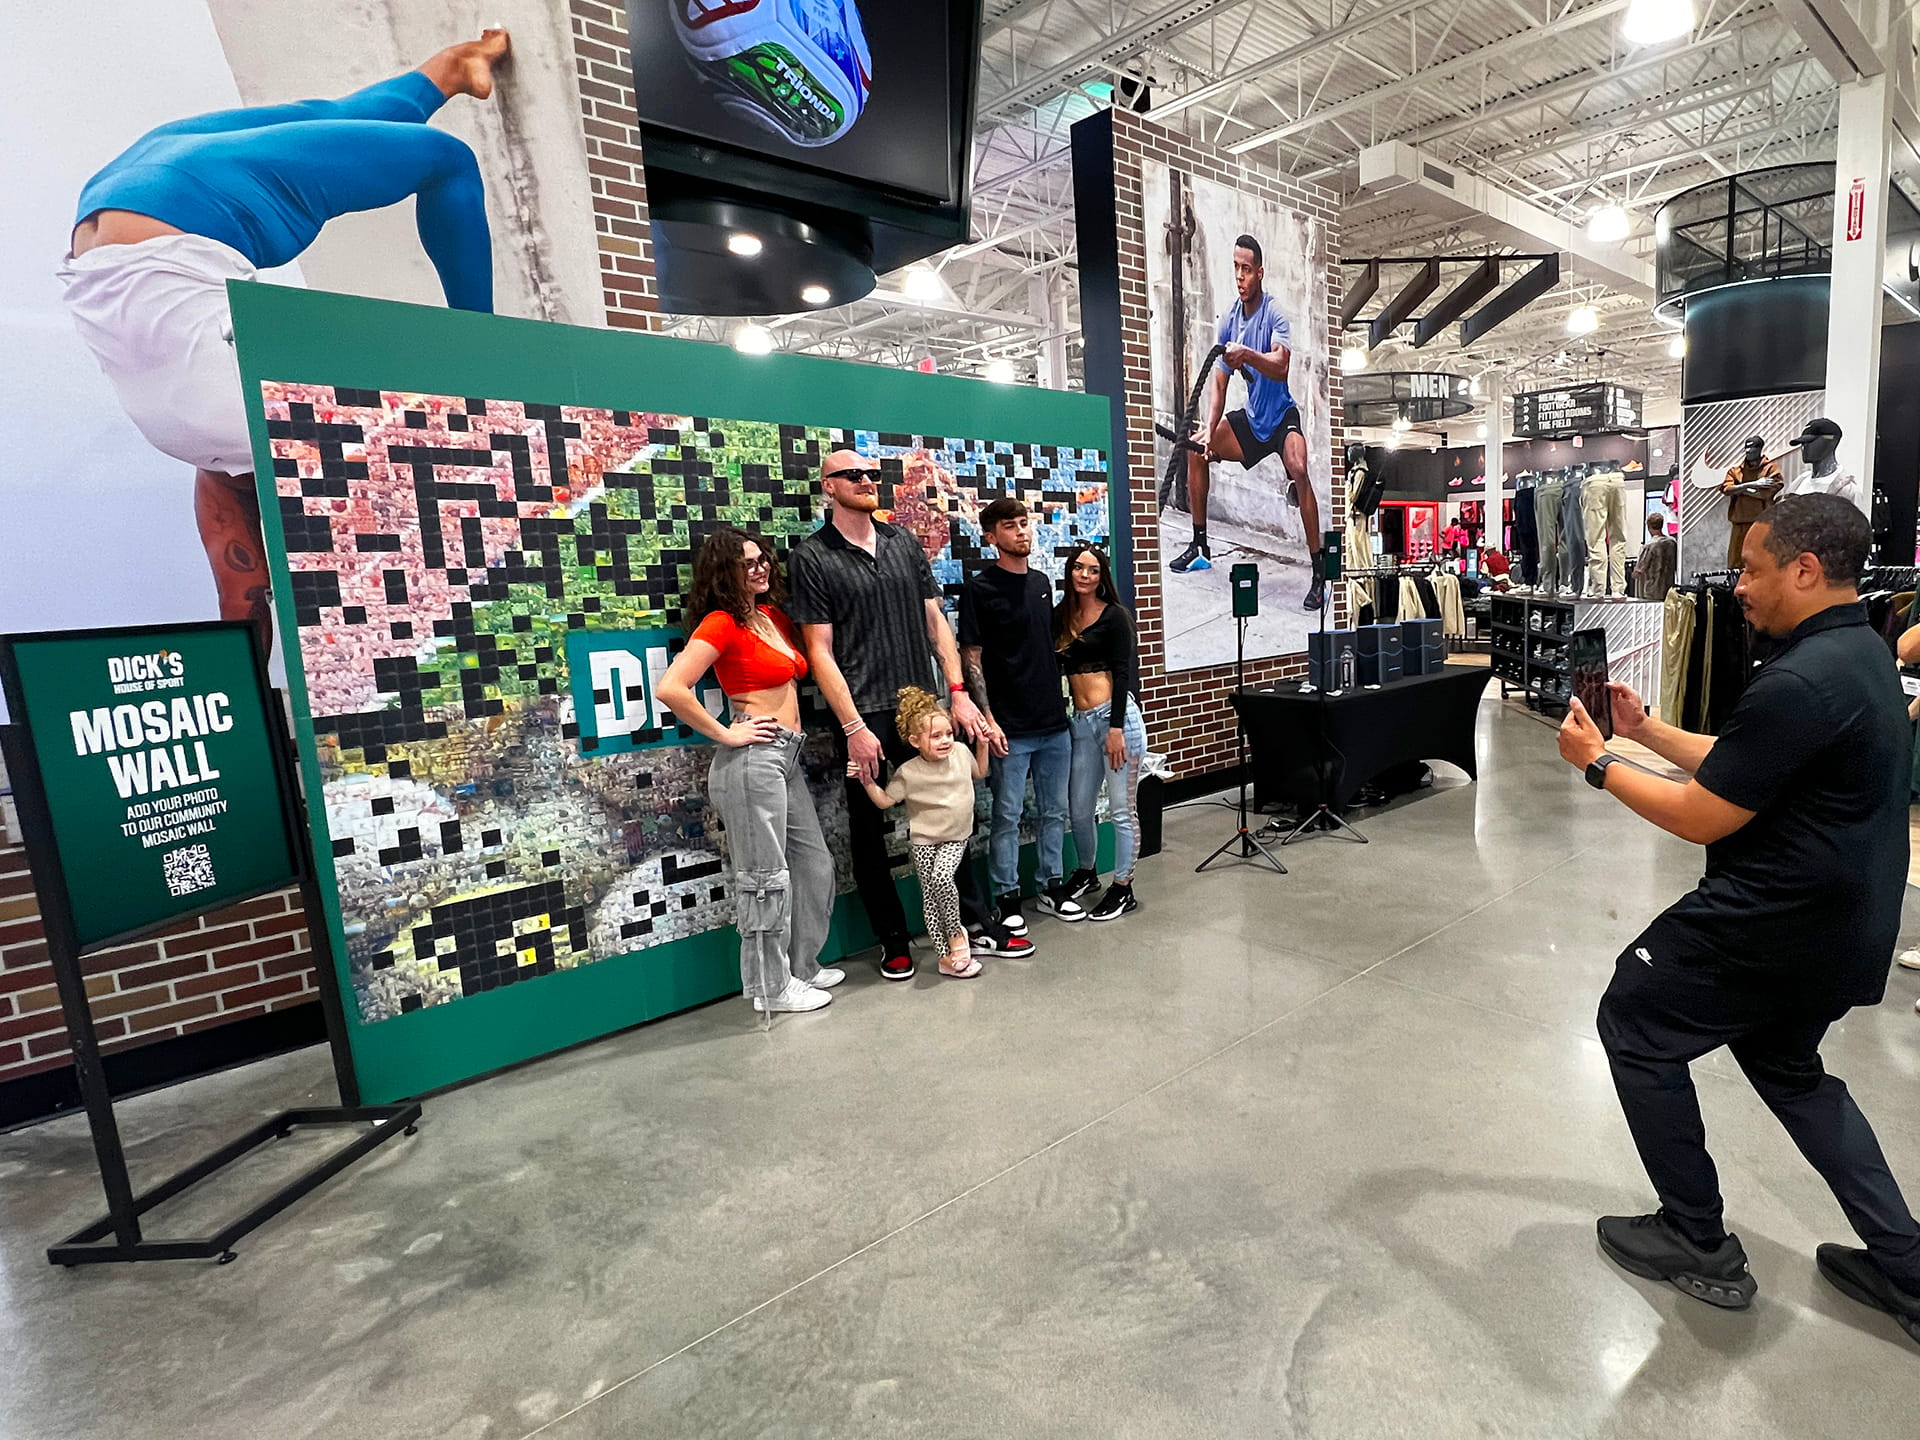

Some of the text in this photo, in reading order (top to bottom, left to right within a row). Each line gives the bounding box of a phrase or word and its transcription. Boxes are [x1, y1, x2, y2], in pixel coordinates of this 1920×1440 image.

[776, 56, 836, 122] TRIONDA
[1411, 374, 1450, 399] MEN
[1538, 399, 1576, 412] FOOTWEAR
[1538, 418, 1572, 431] THE FIELD
[107, 650, 184, 683] DICK'S
[113, 677, 184, 695] HOUSE OF SPORT
[69, 692, 233, 756] MOSAIC
[107, 741, 220, 798] WALL
[120, 800, 227, 837] TO OUR COMMUNITY
[127, 788, 218, 820] ADD YOUR PHOTO
[141, 819, 216, 848] MOSAIC WALL
